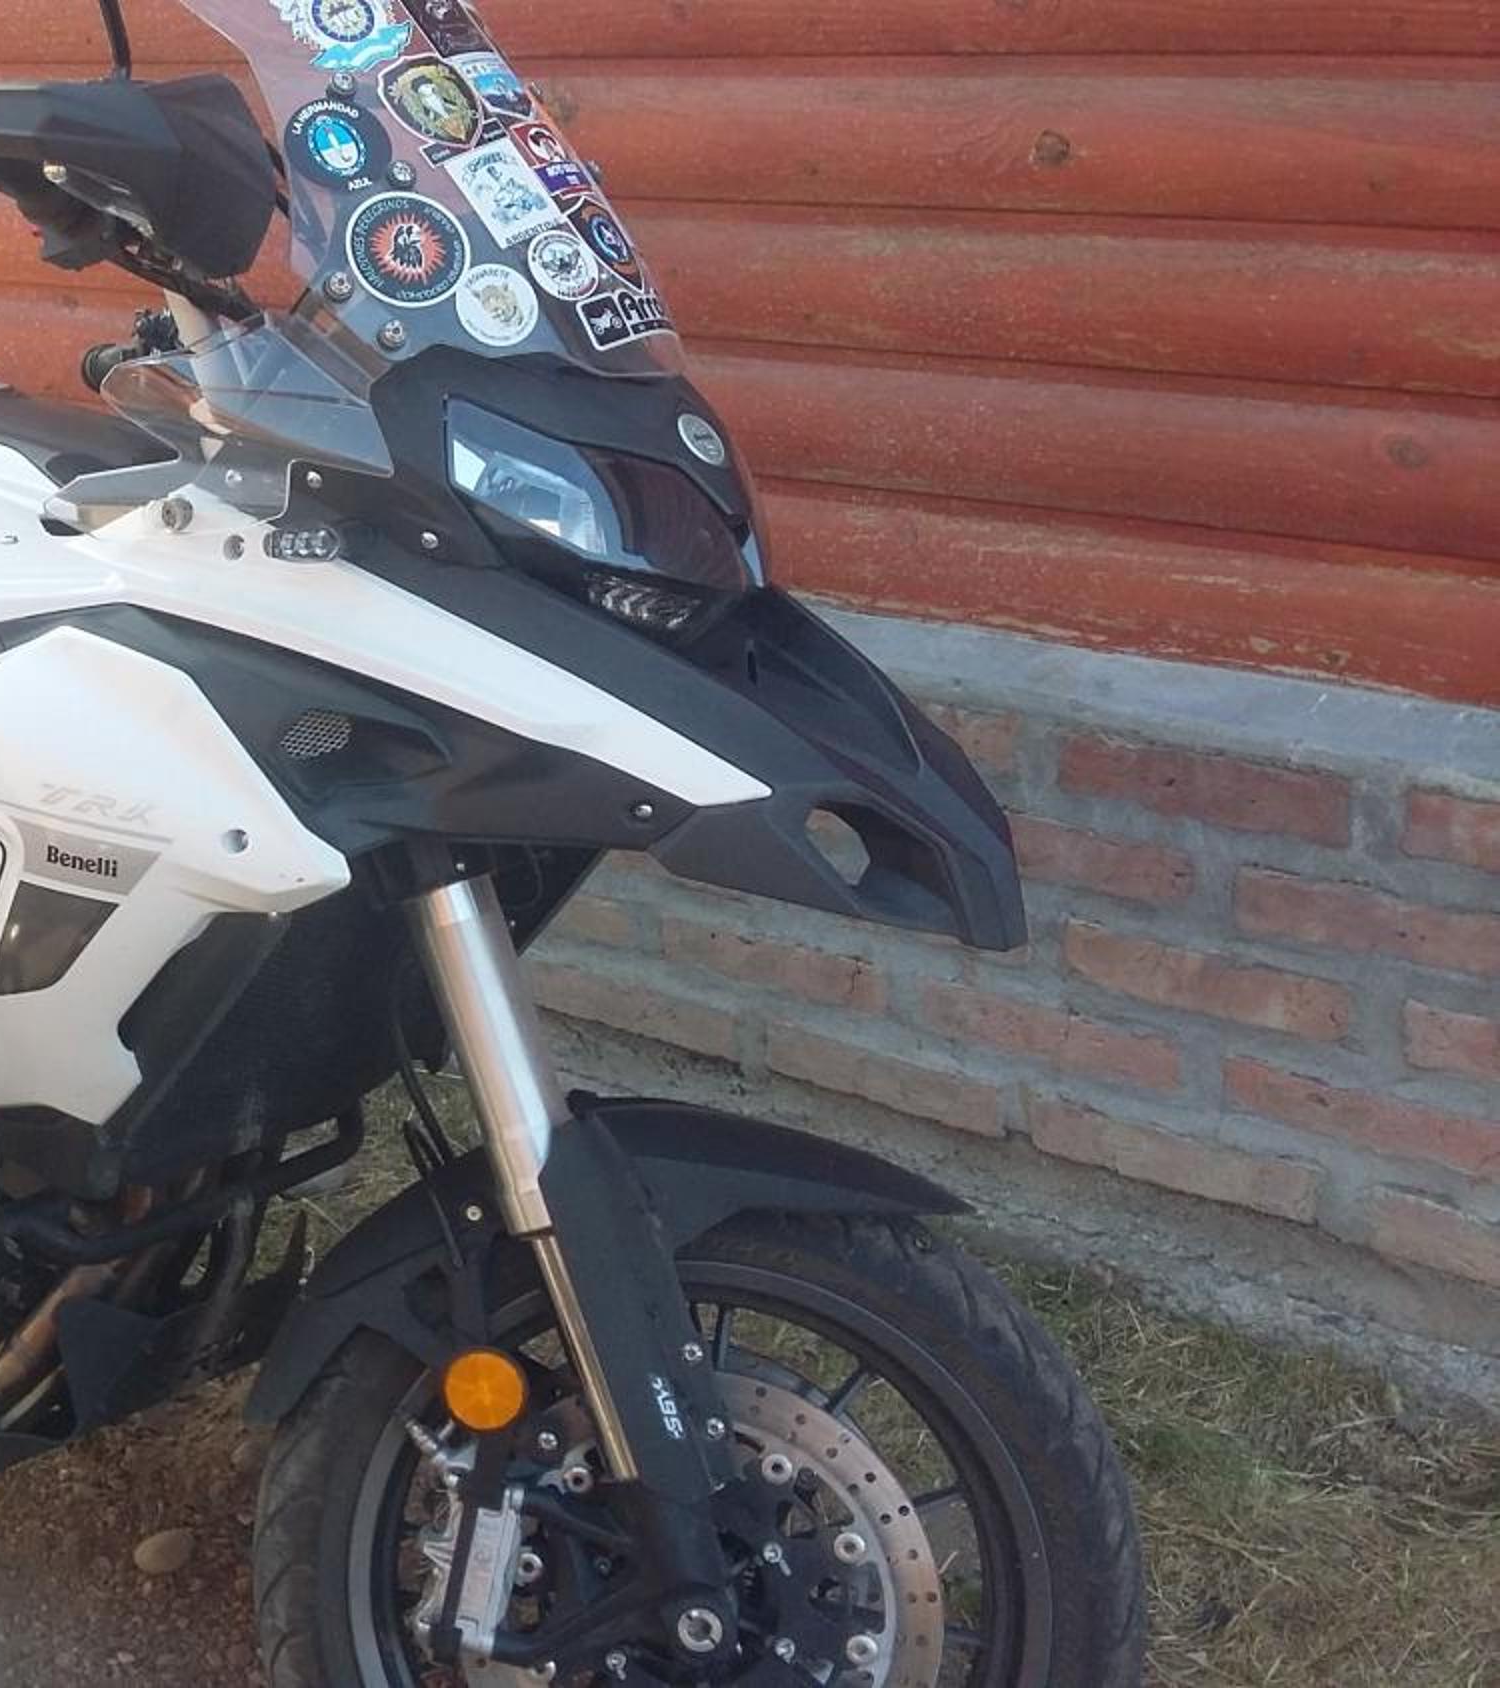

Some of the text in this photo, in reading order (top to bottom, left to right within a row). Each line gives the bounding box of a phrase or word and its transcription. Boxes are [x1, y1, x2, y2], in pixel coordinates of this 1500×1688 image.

[347, 177, 373, 191] AZUL
[41, 782, 156, 826] TRK
[47, 844, 118, 878] Benelli
